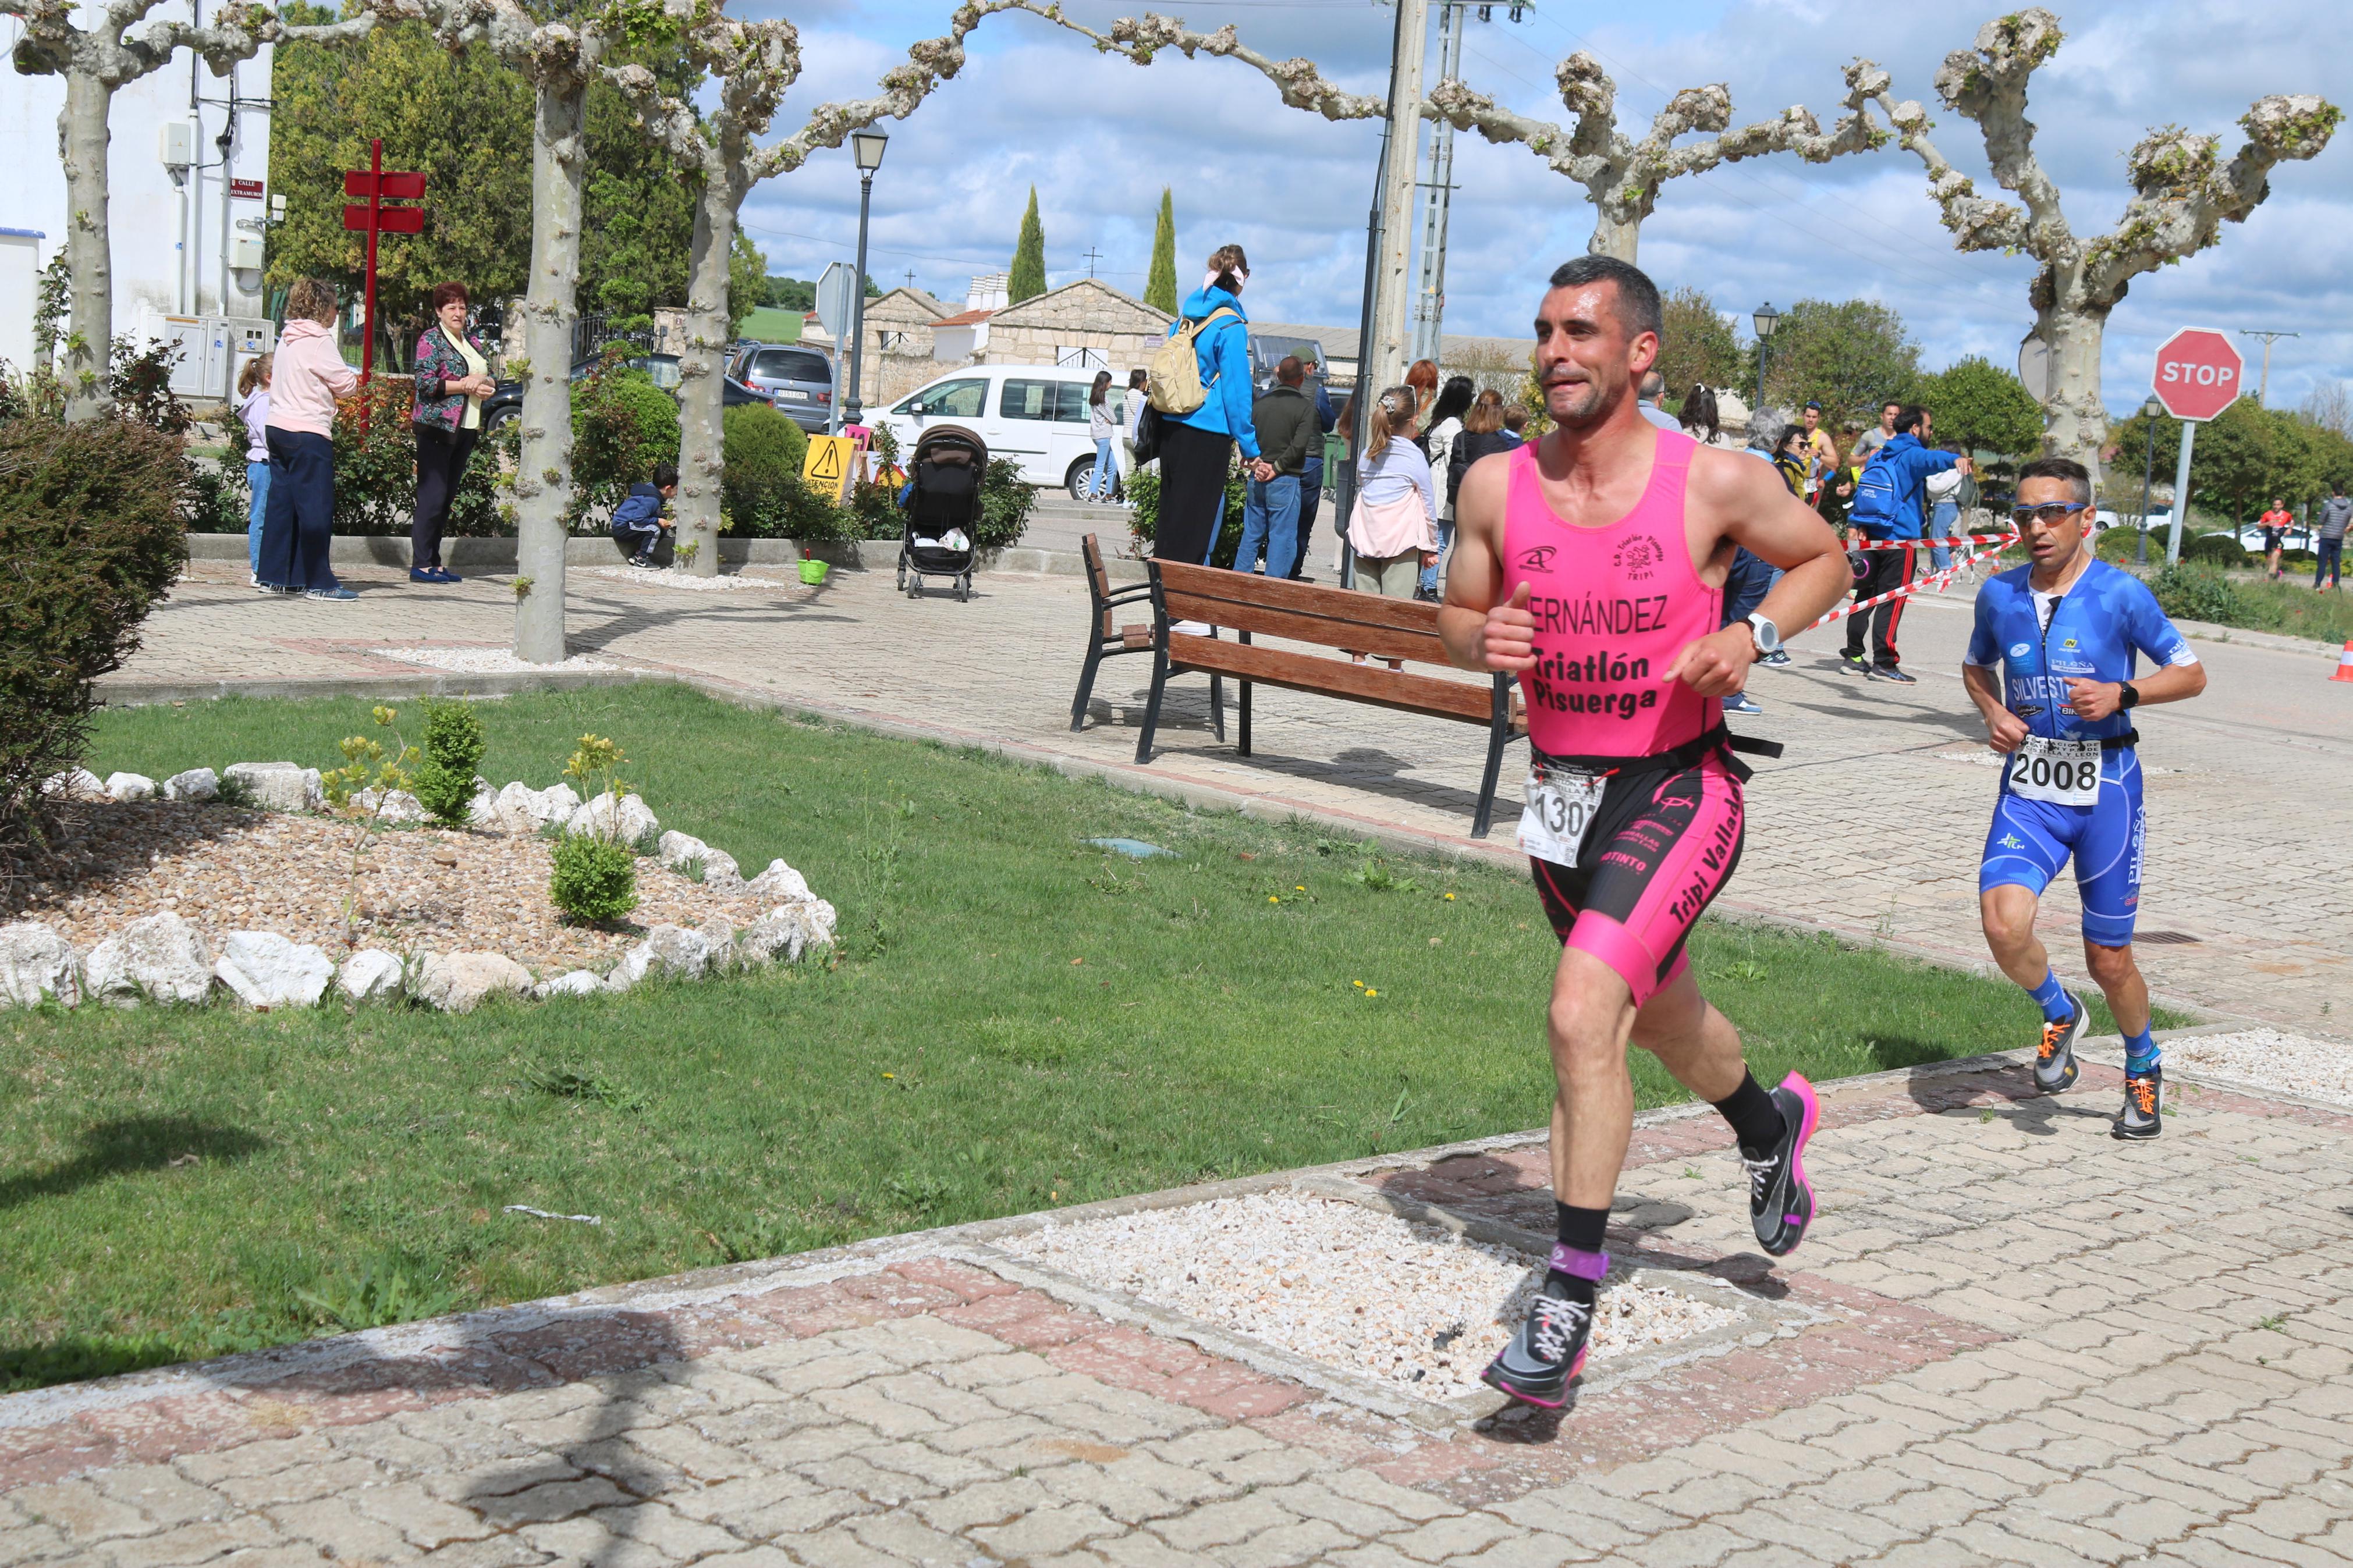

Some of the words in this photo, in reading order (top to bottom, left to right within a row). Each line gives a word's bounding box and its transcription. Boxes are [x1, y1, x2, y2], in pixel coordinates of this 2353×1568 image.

[2162, 361, 2234, 387] STOP
[1628, 571, 1653, 581] TRIPI
[1527, 591, 1668, 635] ERNÁNDEZ
[1531, 646, 1649, 682] Triatlón
[1532, 678, 1658, 720] Pisuerga
[2011, 754, 2096, 791] 2008
[1535, 794, 1596, 837] 130
[1669, 870, 1709, 925] Tripi
